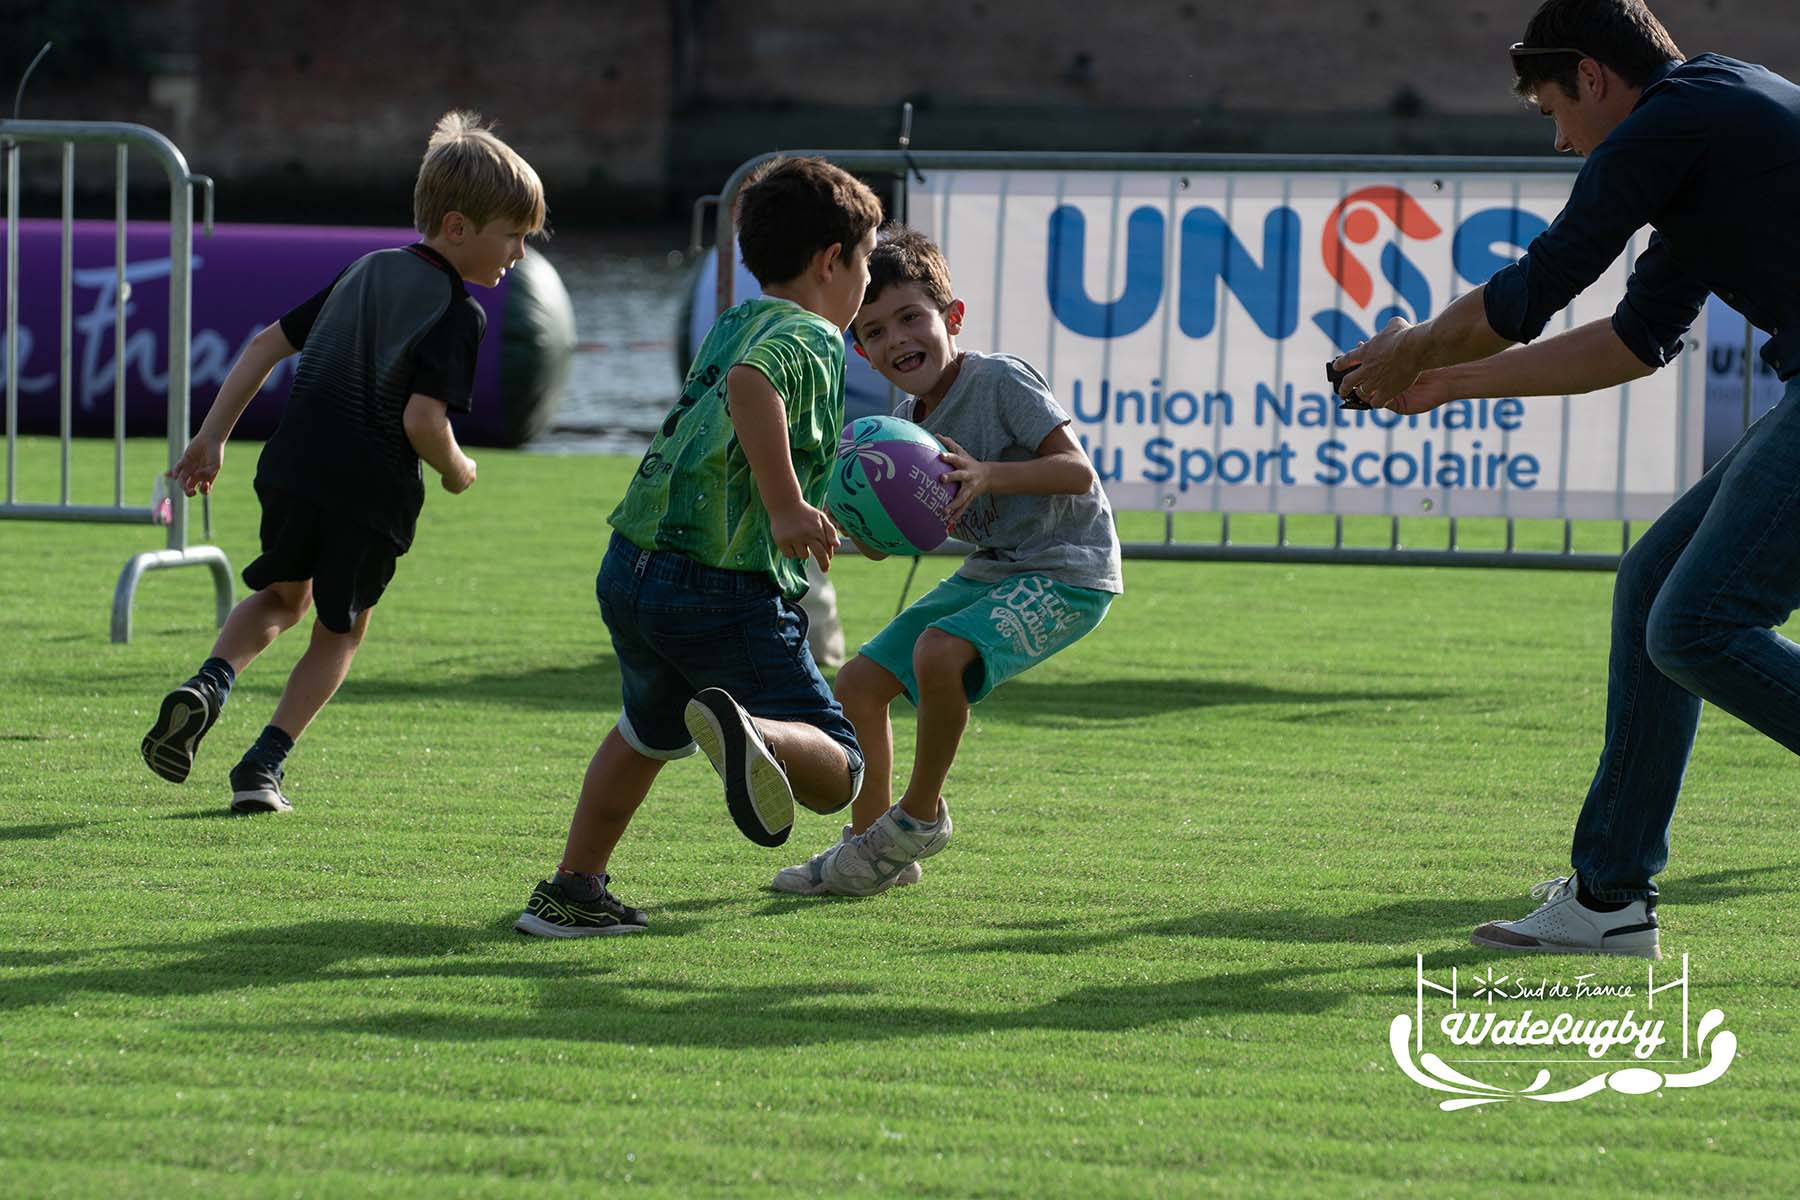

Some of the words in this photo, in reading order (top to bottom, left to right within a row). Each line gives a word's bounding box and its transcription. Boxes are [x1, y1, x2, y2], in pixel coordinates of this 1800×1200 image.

[1072, 378, 1234, 426] Union
[907, 464, 952, 505] NERALE
[1142, 437, 1297, 492] Sport
[1314, 440, 1541, 489] Scolaire
